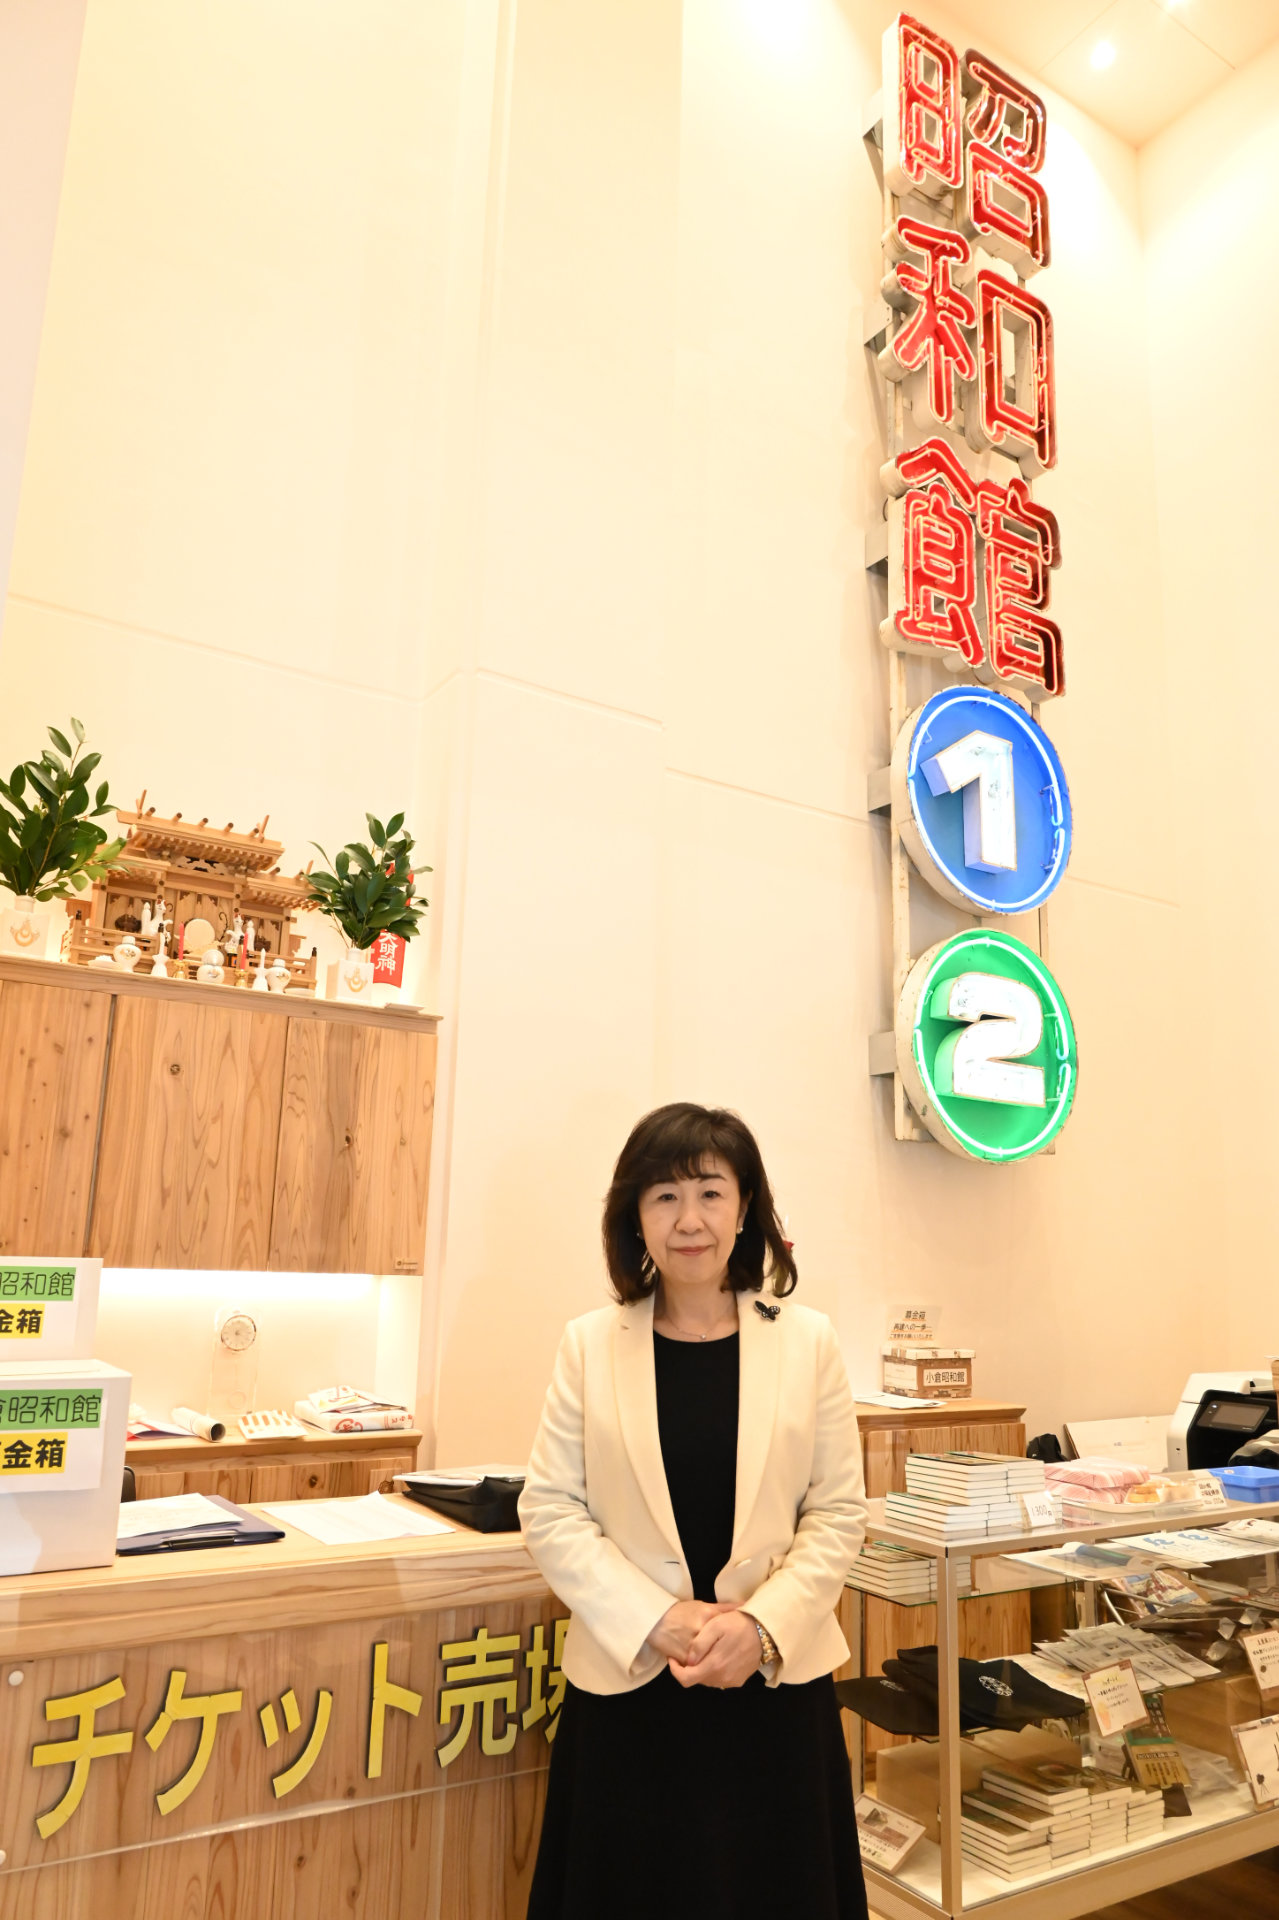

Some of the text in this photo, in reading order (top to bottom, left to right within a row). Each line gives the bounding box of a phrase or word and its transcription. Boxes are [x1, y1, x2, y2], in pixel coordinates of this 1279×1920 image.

[890, 12, 1066, 1107] 昭和館 1 2
[926, 1371, 965, 1384] 小倉昭和館
[0, 1394, 101, 1424] 昭和館
[0, 1438, 65, 1469] 金箱
